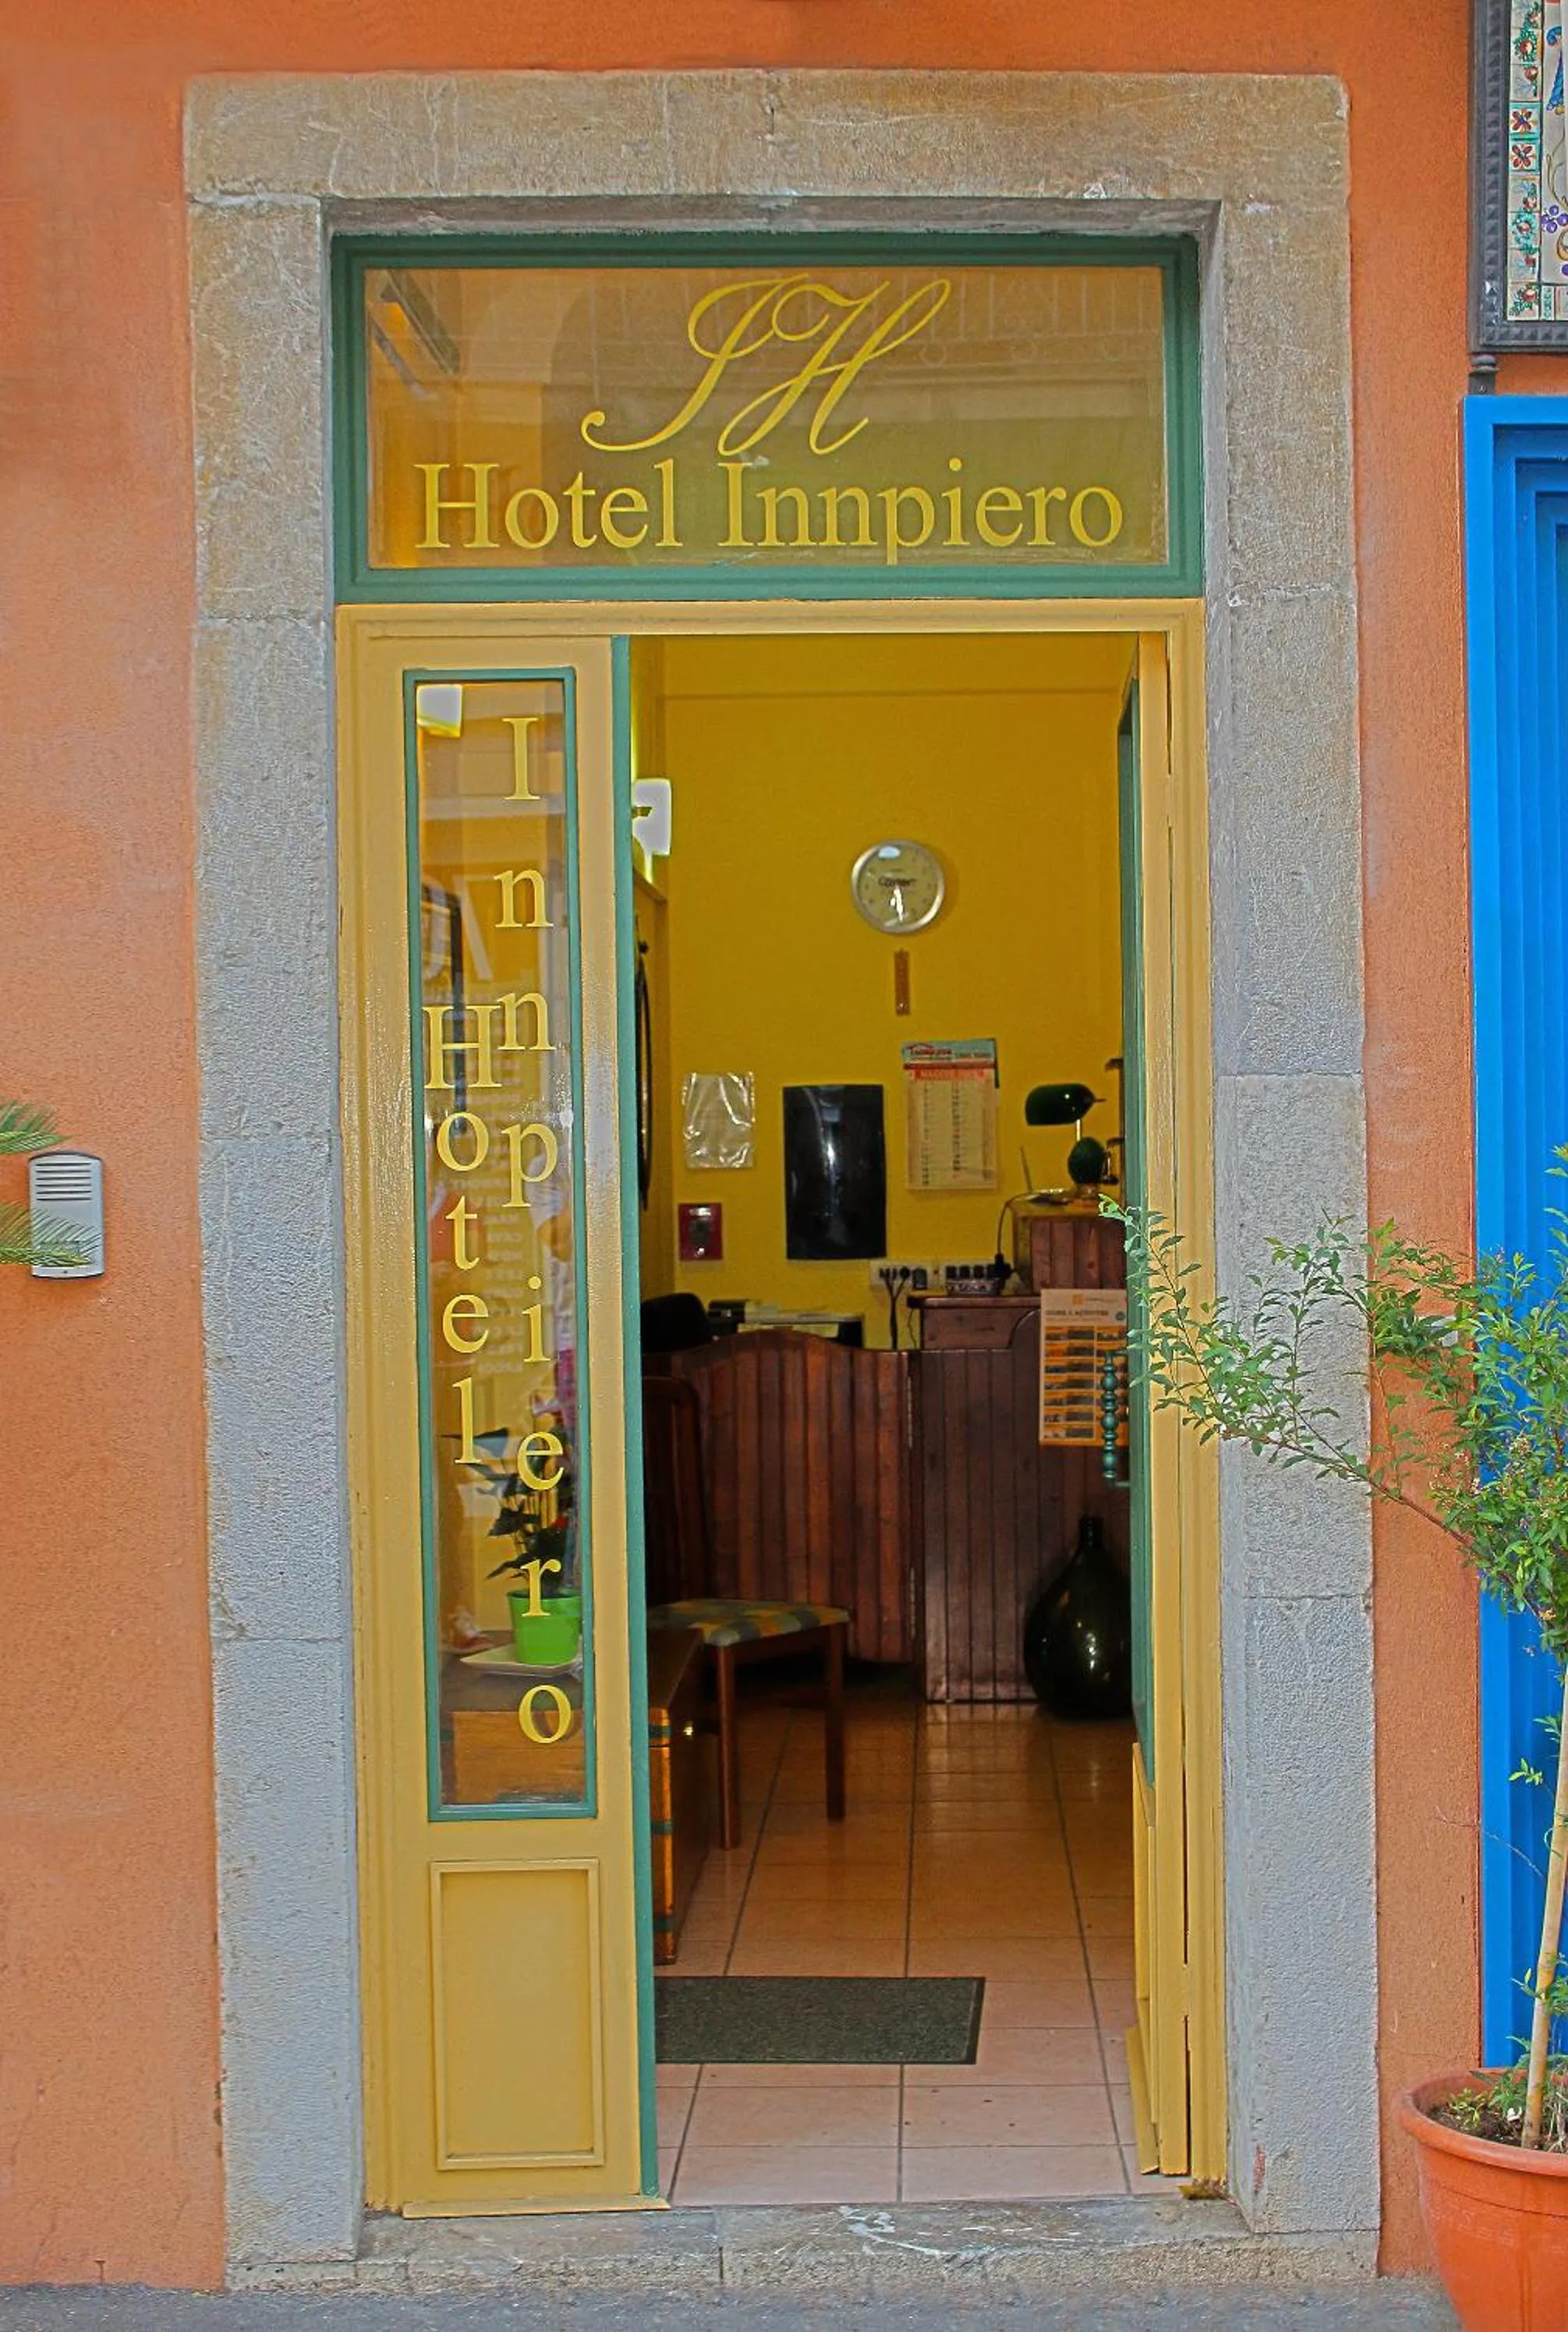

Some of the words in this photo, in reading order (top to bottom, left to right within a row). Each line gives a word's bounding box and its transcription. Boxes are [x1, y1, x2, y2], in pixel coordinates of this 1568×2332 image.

[415, 459, 681, 549] Hotel
[717, 457, 1124, 565] Innpiero
[423, 1005, 503, 1465] Hotel
[494, 717, 572, 1745] Innpiero
